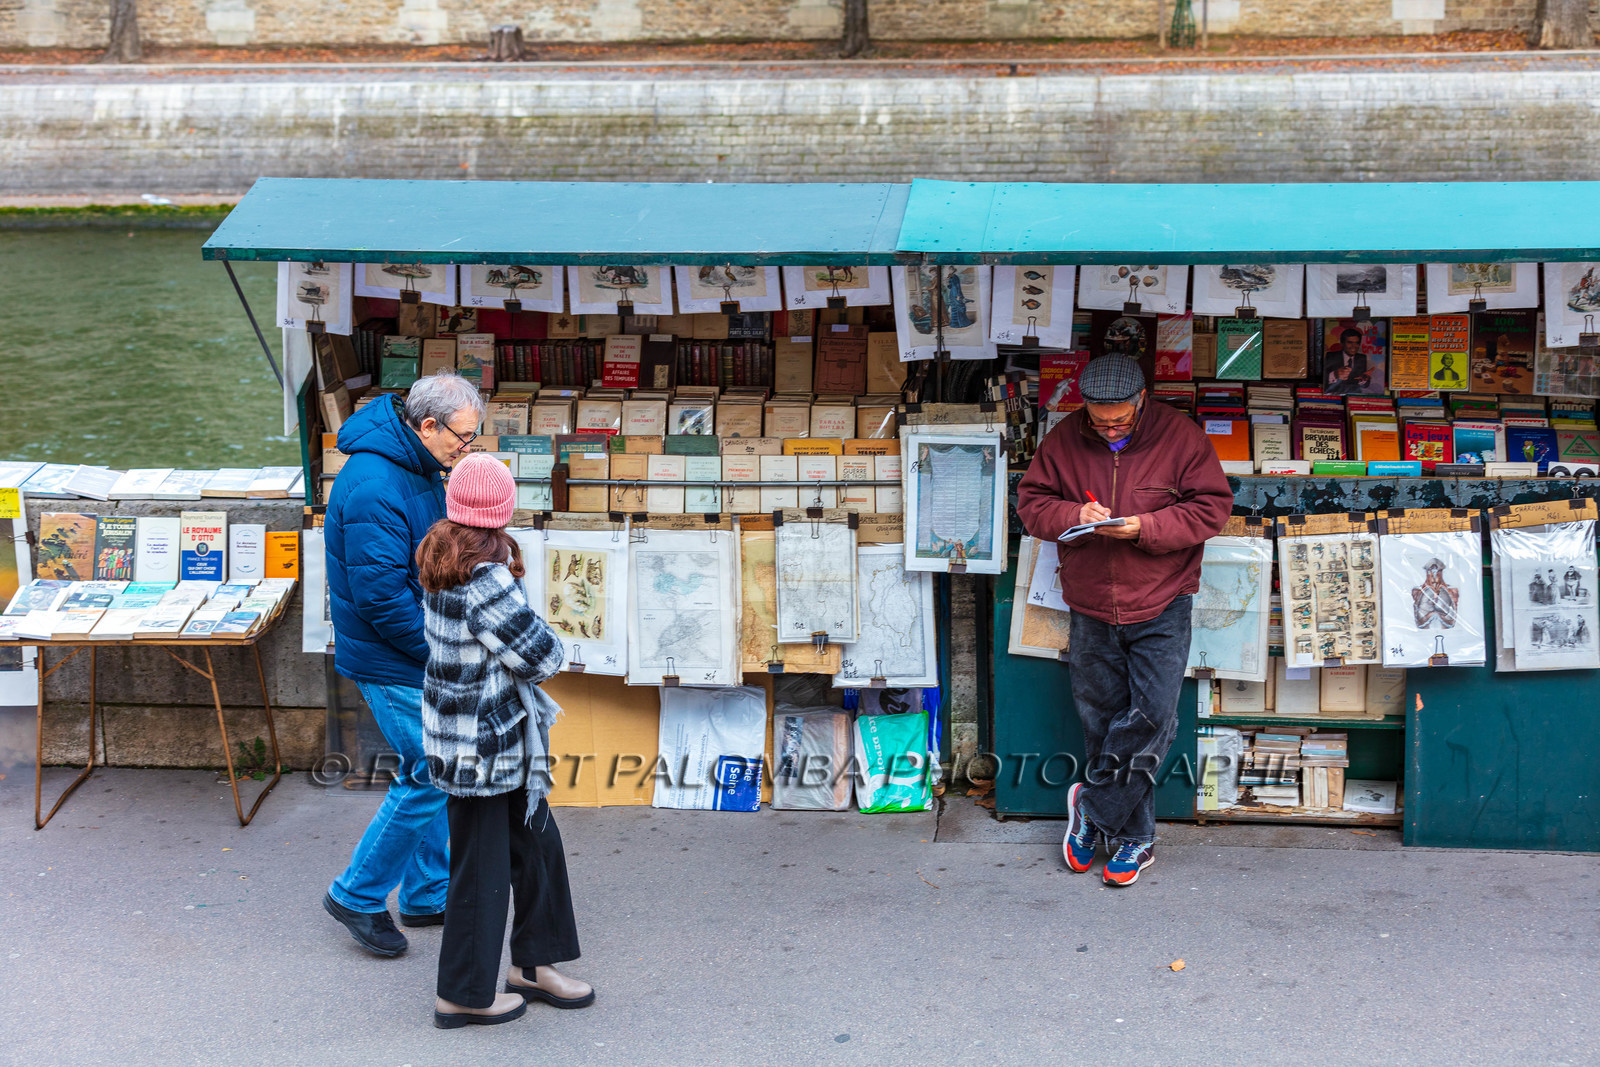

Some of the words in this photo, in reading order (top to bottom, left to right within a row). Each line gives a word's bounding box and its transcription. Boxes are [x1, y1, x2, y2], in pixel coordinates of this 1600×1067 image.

[1407, 430, 1424, 440] Les
[1427, 431, 1451, 442] jeux
[1309, 446, 1336, 454] ECHECS
[1316, 440, 1329, 448] DES
[727, 766, 740, 796] Seine
[743, 768, 754, 782] de
